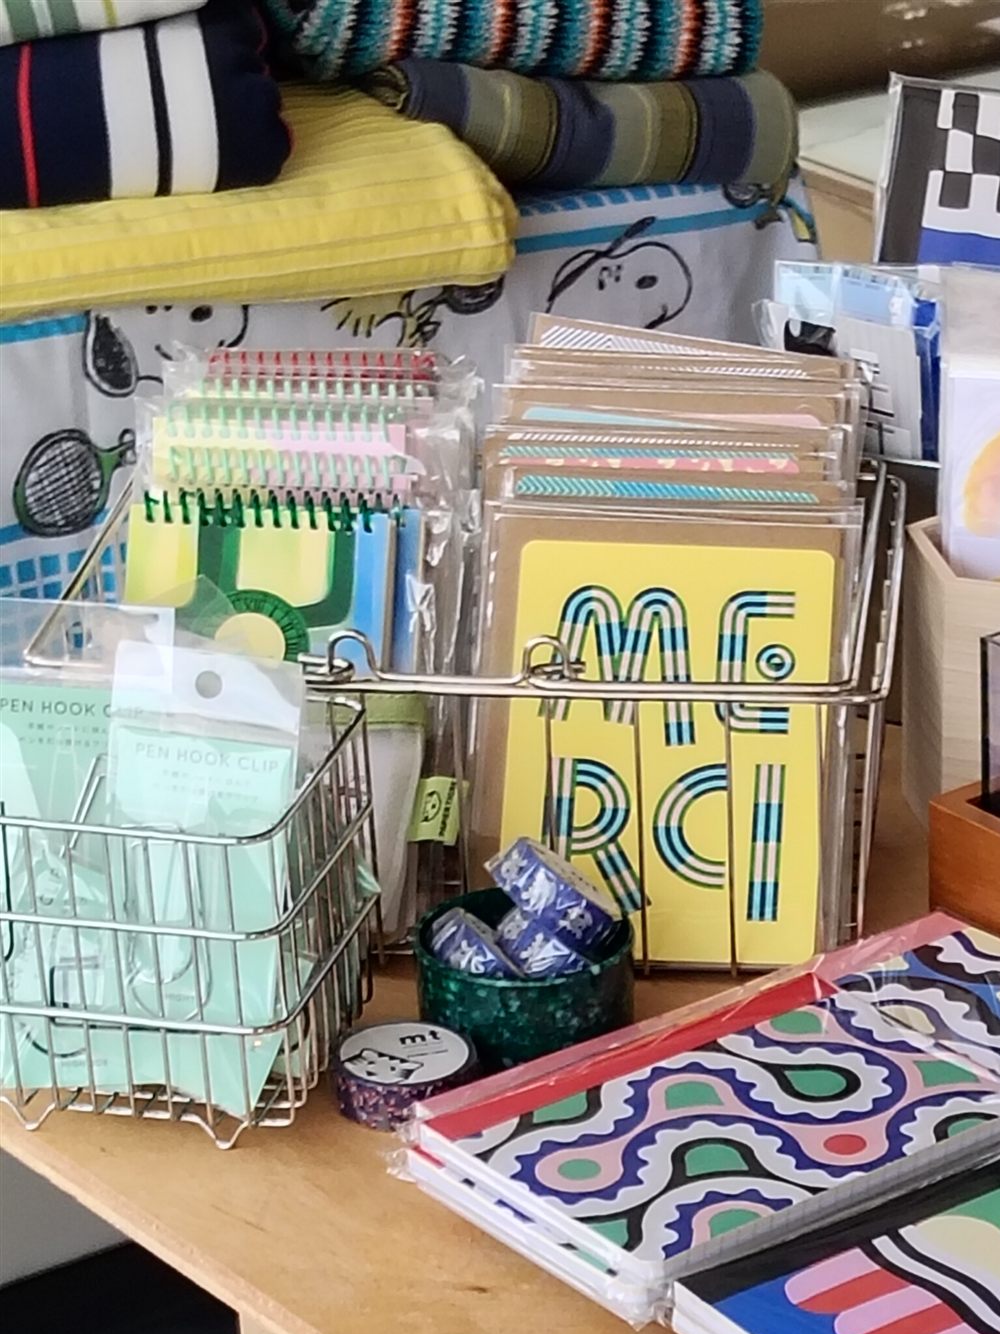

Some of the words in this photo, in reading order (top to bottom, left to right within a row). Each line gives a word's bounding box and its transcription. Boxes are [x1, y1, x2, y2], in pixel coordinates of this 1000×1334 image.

[0, 698, 33, 712] PEN
[41, 700, 96, 716] HOOK
[135, 742, 170, 759] PEN
[177, 749, 230, 768] HOOK
[237, 756, 279, 773] CLIP
[399, 1030, 441, 1045] mt
